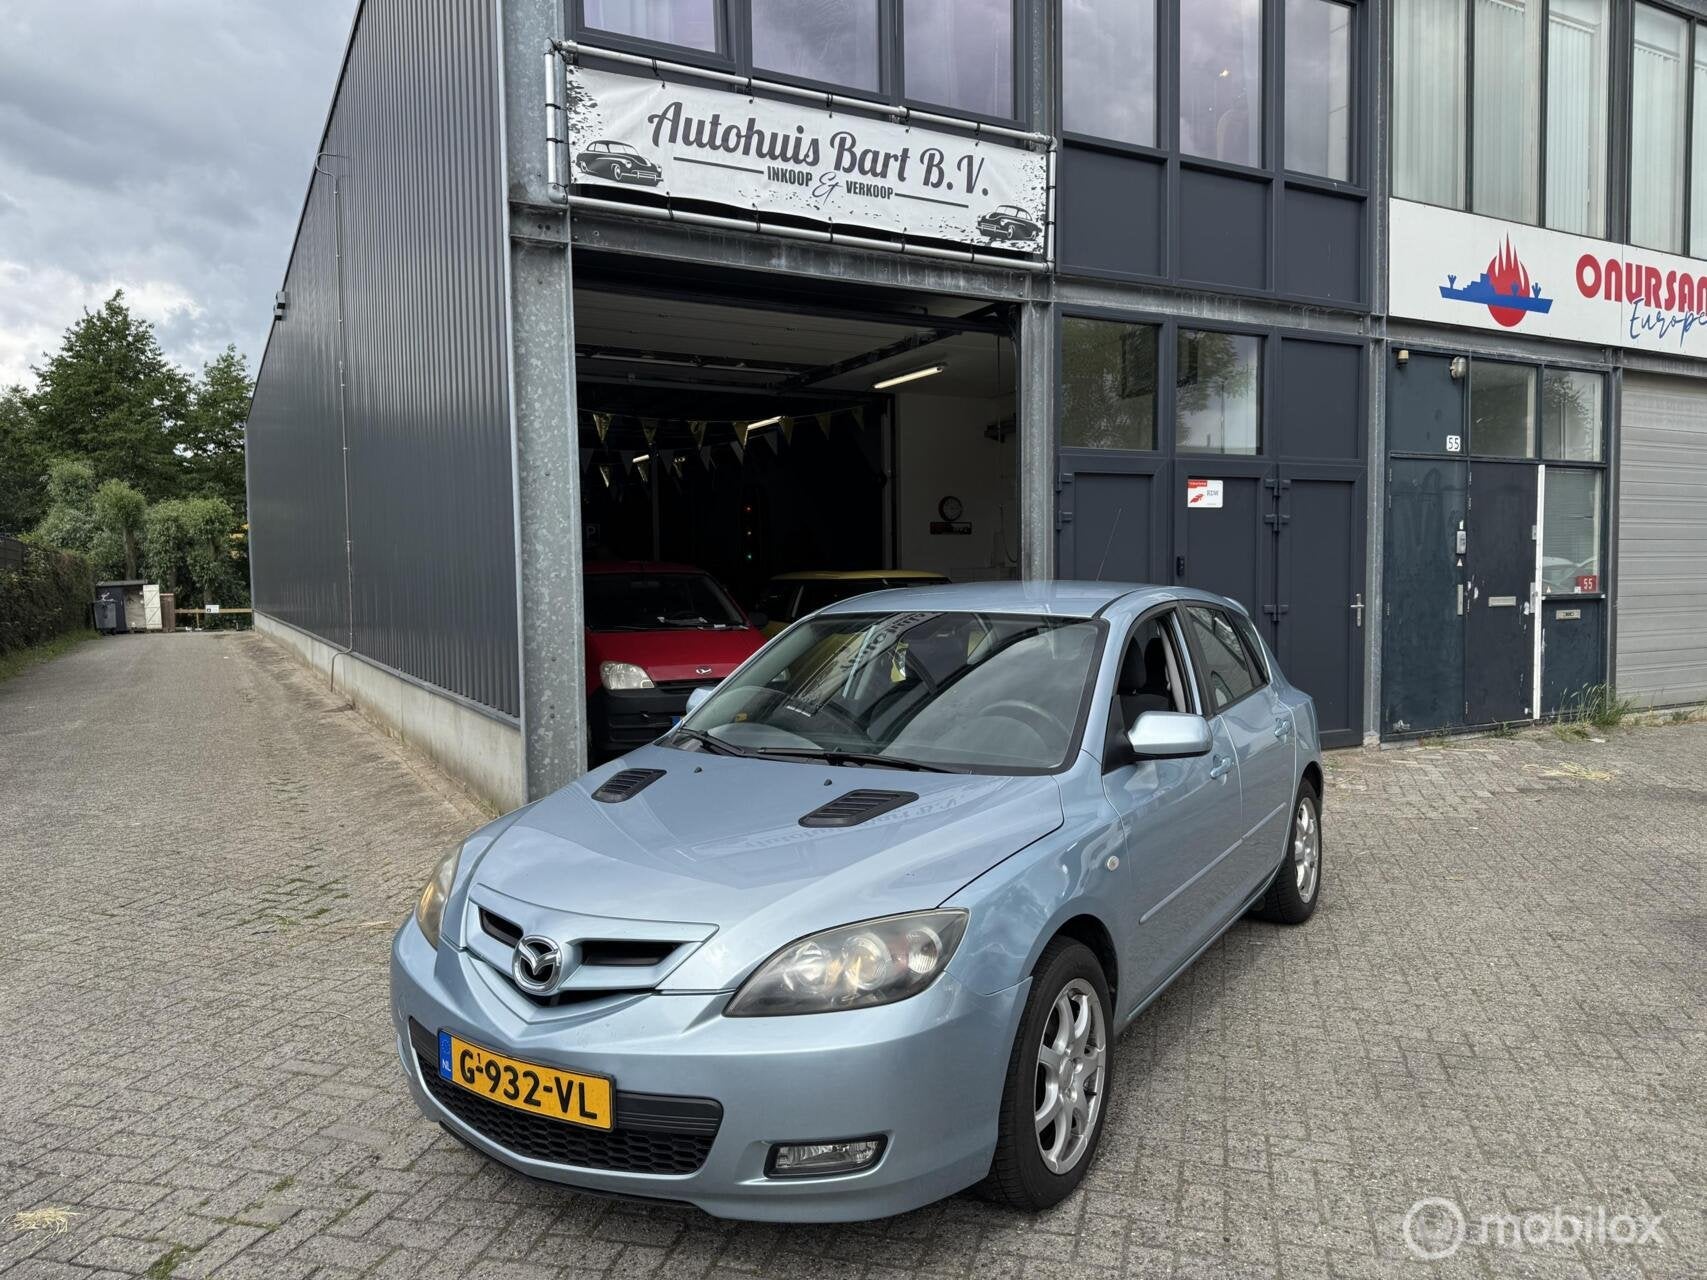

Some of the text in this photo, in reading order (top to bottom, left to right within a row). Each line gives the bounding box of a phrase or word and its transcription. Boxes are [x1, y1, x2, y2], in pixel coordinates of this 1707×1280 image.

[648, 102, 989, 196] Autohuis Bart B.V.
[767, 166, 894, 206] INKOOP & VERKOOP
[1448, 437, 1460, 450] 55
[1583, 578, 1593, 590] 55
[442, 1049, 598, 1120] NL G-932-VL
